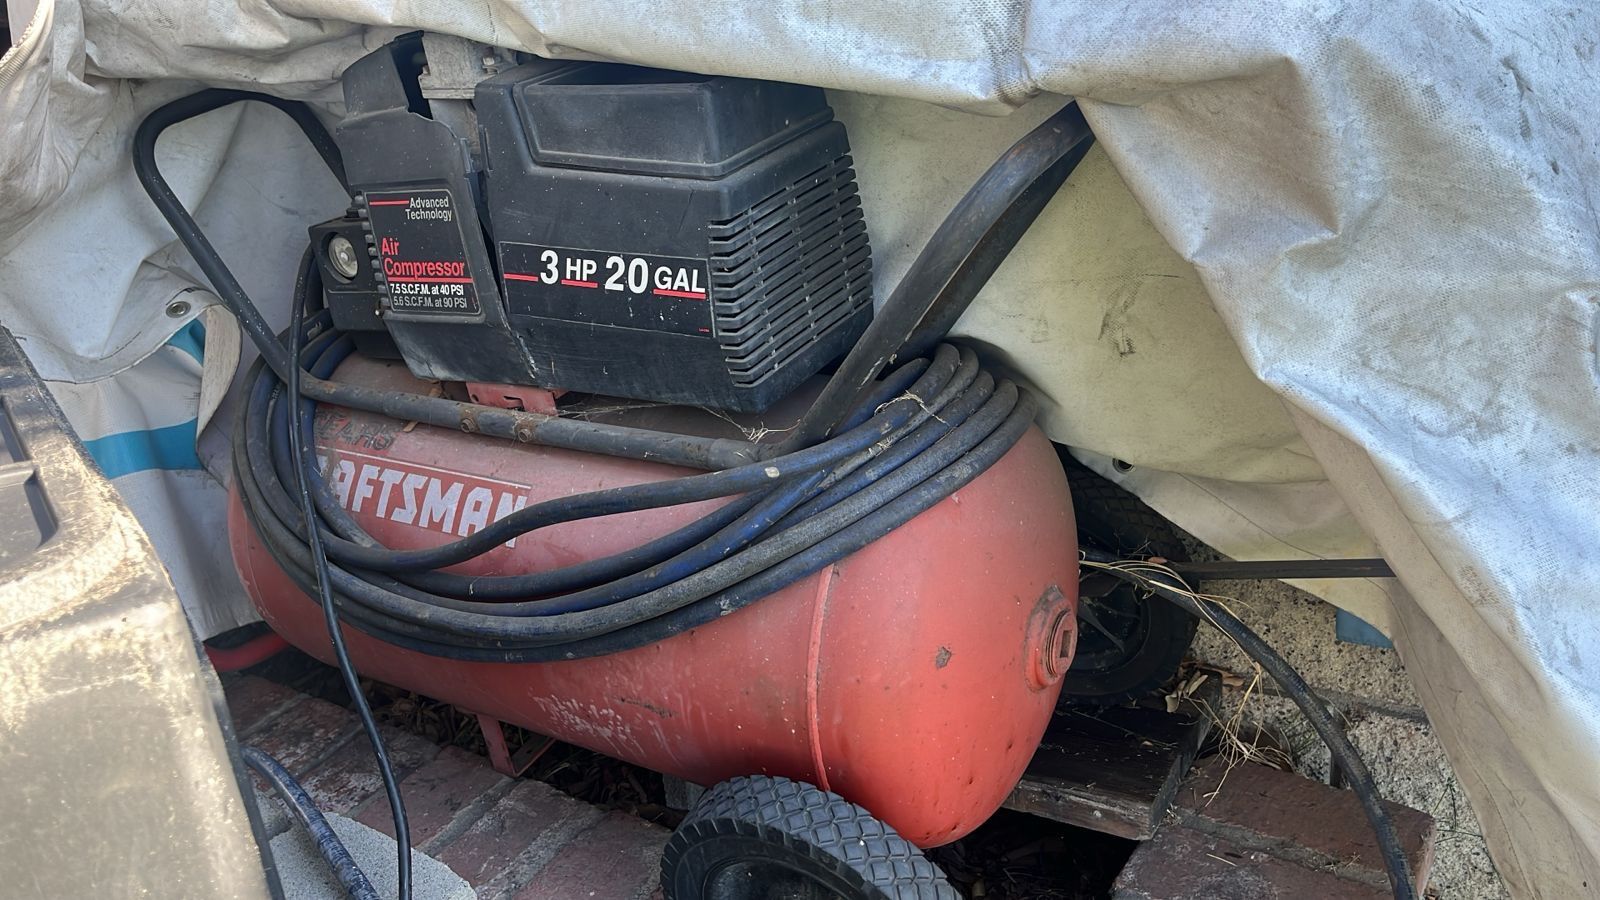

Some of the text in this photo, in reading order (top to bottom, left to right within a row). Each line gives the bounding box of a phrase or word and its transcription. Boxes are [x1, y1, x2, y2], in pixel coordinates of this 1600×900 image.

[409, 196, 449, 209] Advanced
[405, 208, 452, 221] Technology
[381, 237, 400, 255] Air
[384, 258, 465, 279] Compressor
[540, 250, 706, 293] 3 HP 20 GAL
[401, 283, 431, 295] S.C.F.M.
[431, 286, 440, 295] at
[440, 284, 450, 295] 40
[450, 285, 465, 296] PSI
[393, 295, 468, 308] 5.6 S.C.F.M. at 90 PSI
